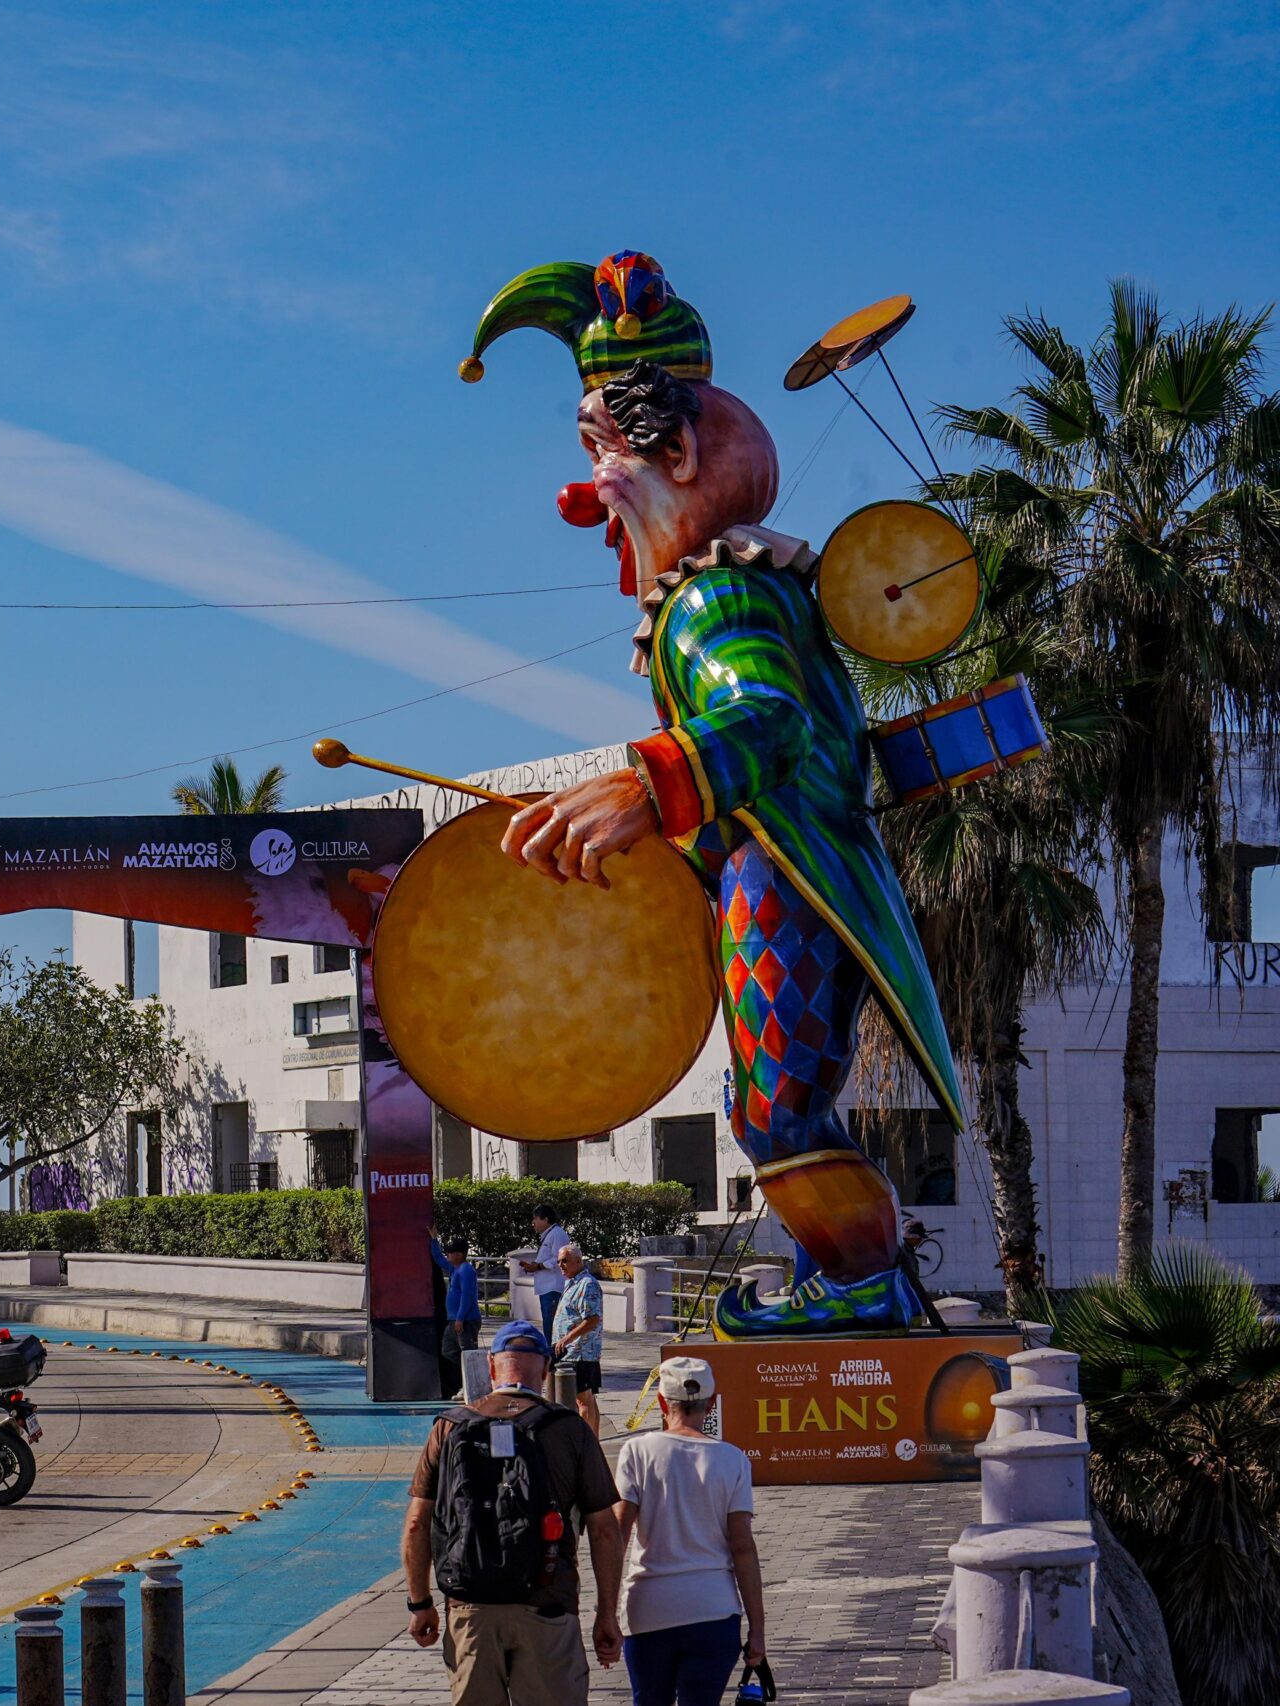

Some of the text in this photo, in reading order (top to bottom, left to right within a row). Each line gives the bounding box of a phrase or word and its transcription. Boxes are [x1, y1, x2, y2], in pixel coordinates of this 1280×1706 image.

[5, 844, 110, 864] MAZATLÁN
[137, 842, 218, 855] AMAMOS
[301, 840, 370, 857] CULTURA
[370, 1170, 429, 1195] PACIFICO
[756, 1361, 820, 1375] CARNAVAL
[839, 1359, 883, 1372] ARRIBA
[830, 1371, 892, 1387] TAMBORA
[753, 1395, 898, 1434] HANS
[781, 1448, 831, 1458] MAZATLÁN
[919, 1443, 952, 1452] CULTURA
